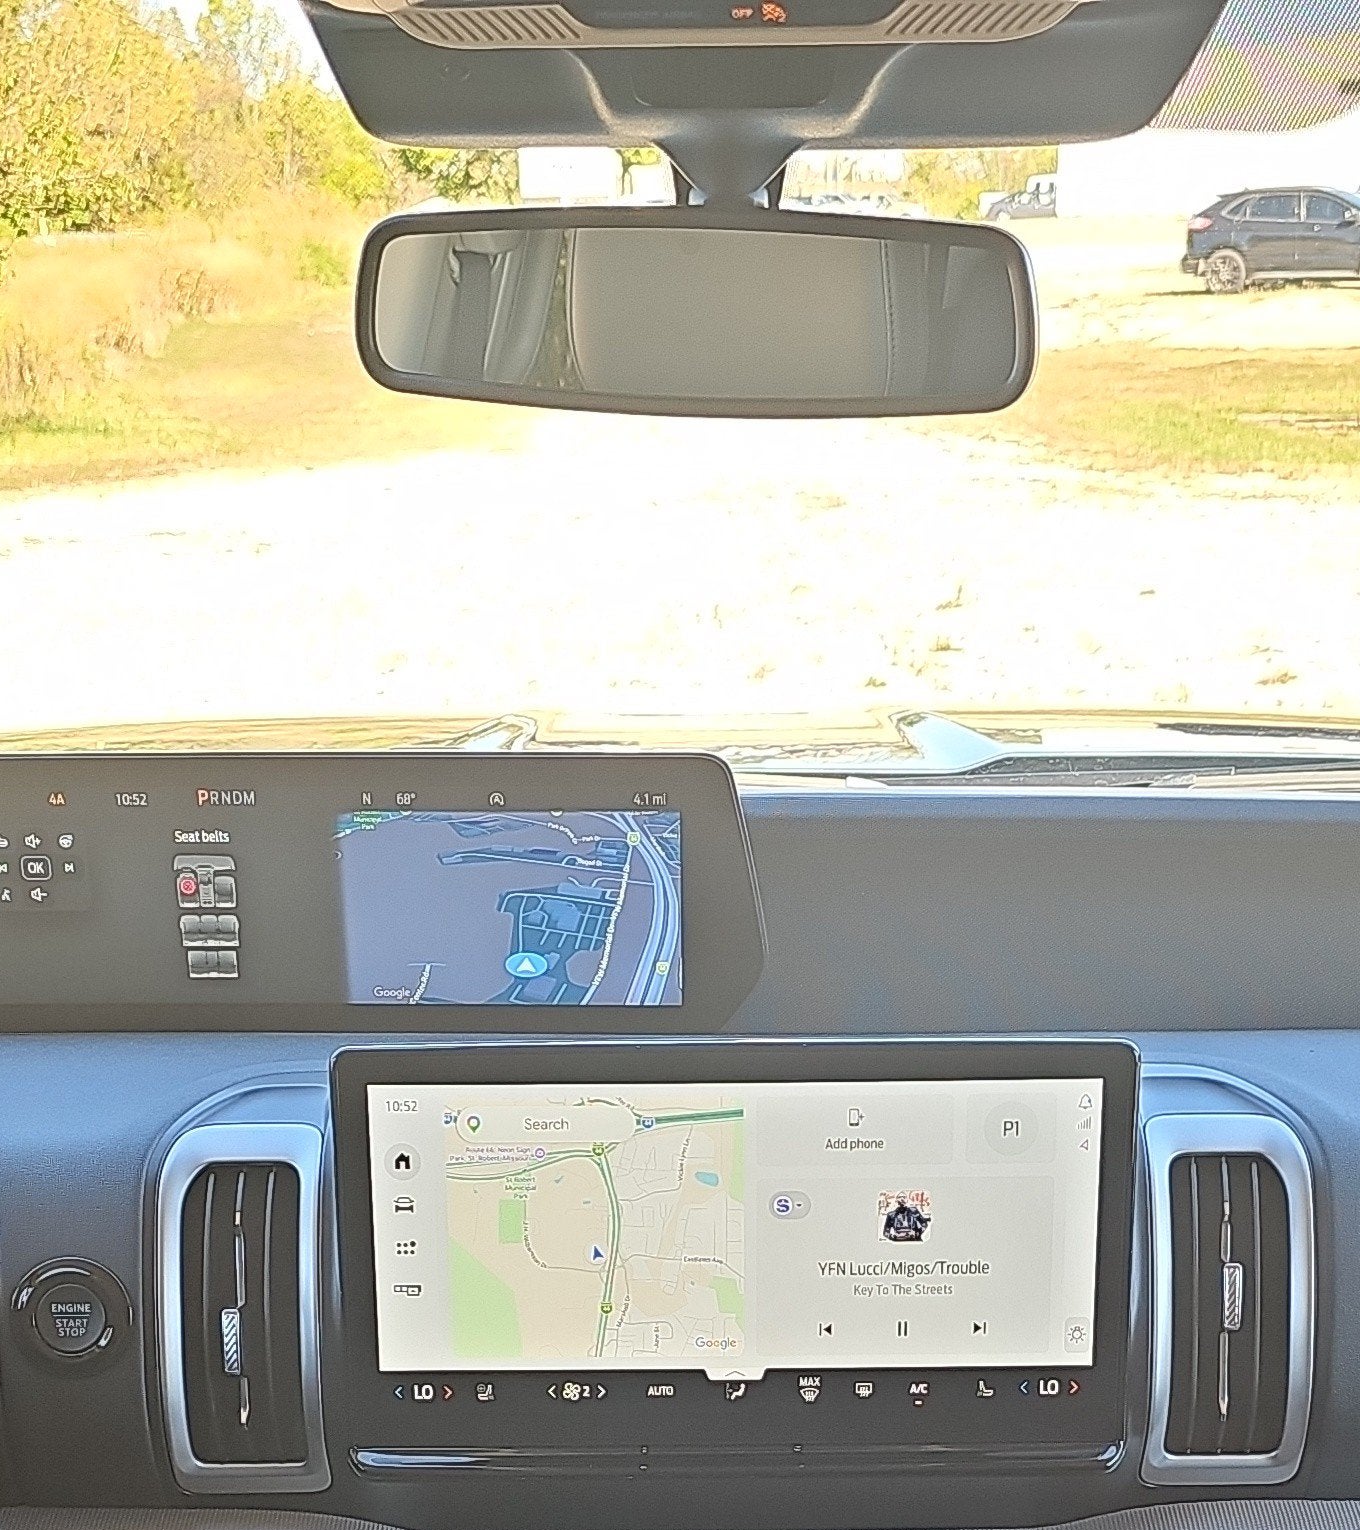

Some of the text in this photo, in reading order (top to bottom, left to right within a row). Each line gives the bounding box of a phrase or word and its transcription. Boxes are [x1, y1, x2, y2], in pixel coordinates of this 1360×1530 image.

[115, 793, 148, 806] 10:52
[362, 793, 372, 805] N
[633, 792, 667, 806] 4.1 mi
[174, 830, 230, 844] Seat belts
[27, 861, 45, 875] OK
[373, 985, 412, 1000] Google
[385, 1100, 418, 1113] 10:52
[523, 1117, 570, 1131] Search
[1003, 1121, 1020, 1137] P1
[824, 1137, 885, 1151] Add phone
[817, 1260, 990, 1278] YFN Lucci/Migos/Trouble
[853, 1283, 954, 1297] Key To The Streets
[51, 1303, 92, 1313] ENGINE
[55, 1318, 89, 1328] START
[57, 1327, 86, 1337] STOP
[695, 1336, 737, 1350] Google
[798, 1376, 822, 1387] MAX
[909, 1383, 929, 1394] A/C
[1039, 1379, 1060, 1395] LO
[413, 1384, 436, 1400] LO
[582, 1385, 591, 1398] 2
[646, 1384, 675, 1397] AUTO
